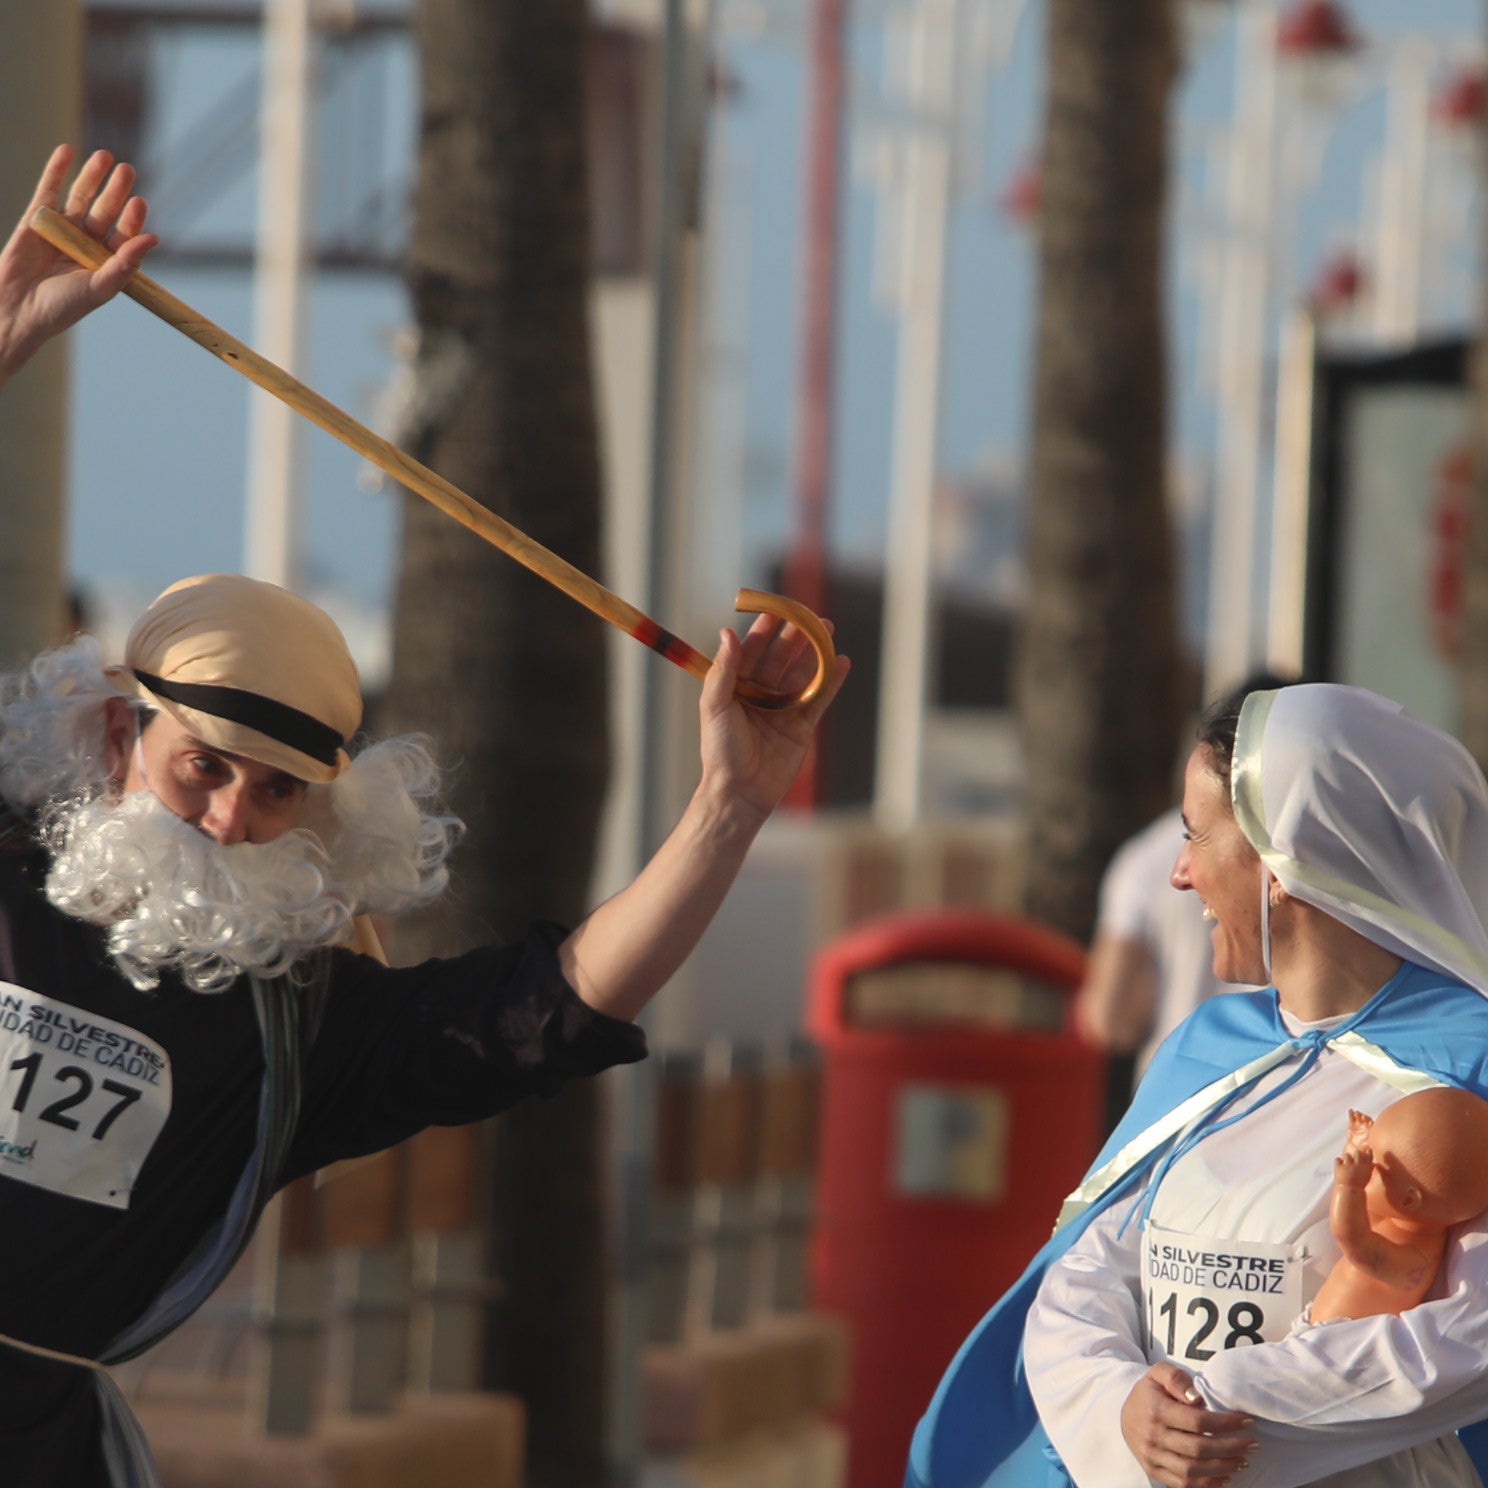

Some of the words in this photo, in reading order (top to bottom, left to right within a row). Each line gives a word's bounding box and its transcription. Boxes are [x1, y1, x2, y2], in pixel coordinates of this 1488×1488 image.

[28, 1004, 163, 1069] SILVESTRE
[58, 1032, 91, 1058] DE
[1162, 1245, 1285, 1273] SILVESTRE
[1183, 1265, 1207, 1287] DE
